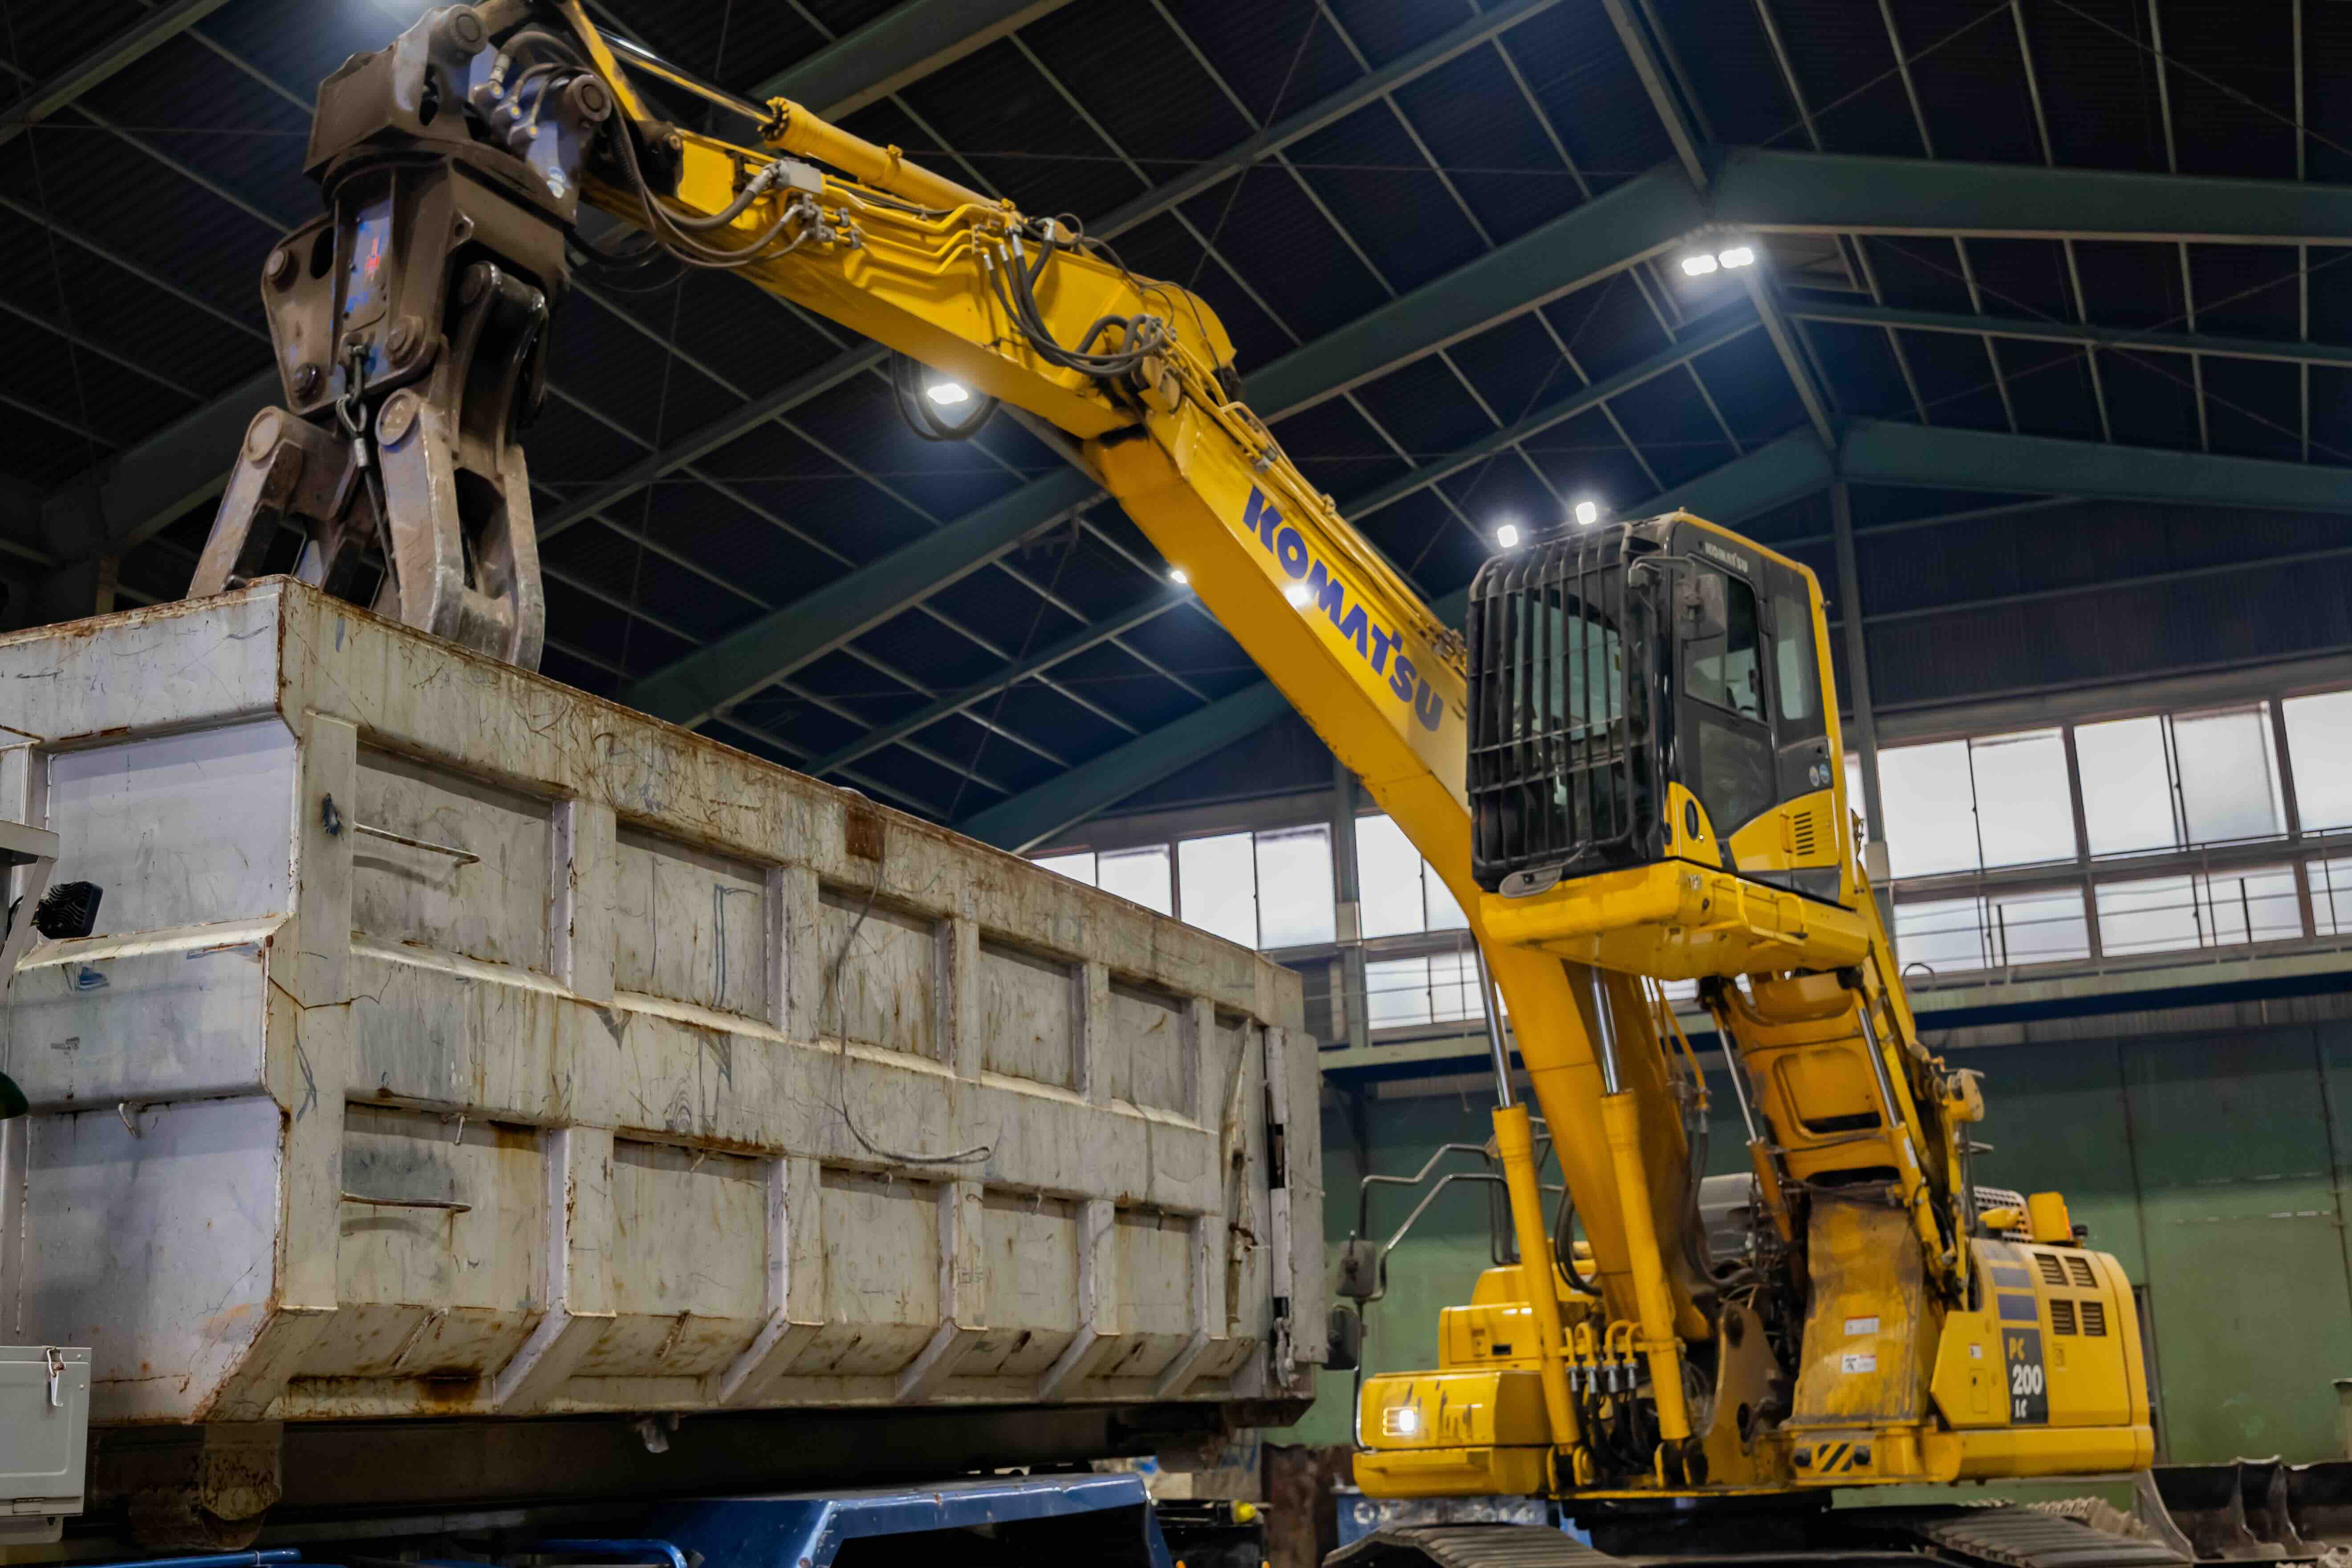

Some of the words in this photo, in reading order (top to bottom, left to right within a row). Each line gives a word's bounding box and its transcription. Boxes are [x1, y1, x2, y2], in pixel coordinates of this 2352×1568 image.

[1704, 541, 1749, 573] KOMATSU
[1243, 484, 1444, 732] KOMATSU
[2008, 1336, 2025, 1361] PC
[2012, 1364, 2043, 1395] 200
